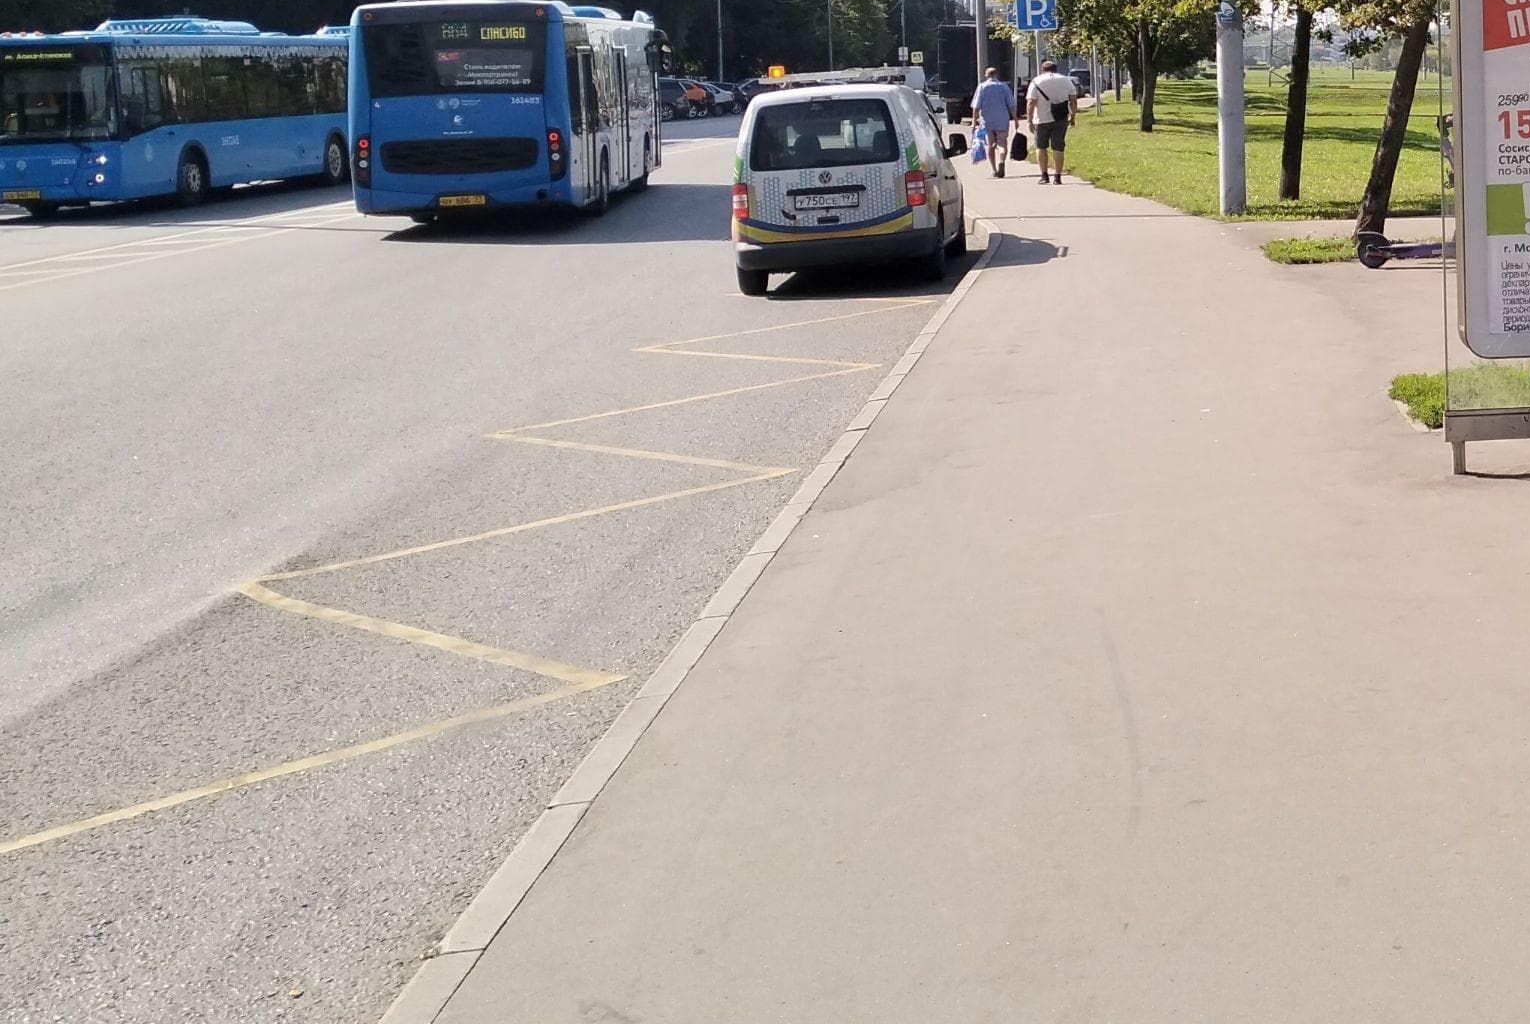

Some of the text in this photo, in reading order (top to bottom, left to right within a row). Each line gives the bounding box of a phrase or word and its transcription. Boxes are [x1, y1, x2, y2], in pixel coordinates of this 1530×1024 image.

[480, 26, 526, 40] СПАСИБО
[841, 194, 856, 202] 197
[1503, 245, 1511, 253] г.
